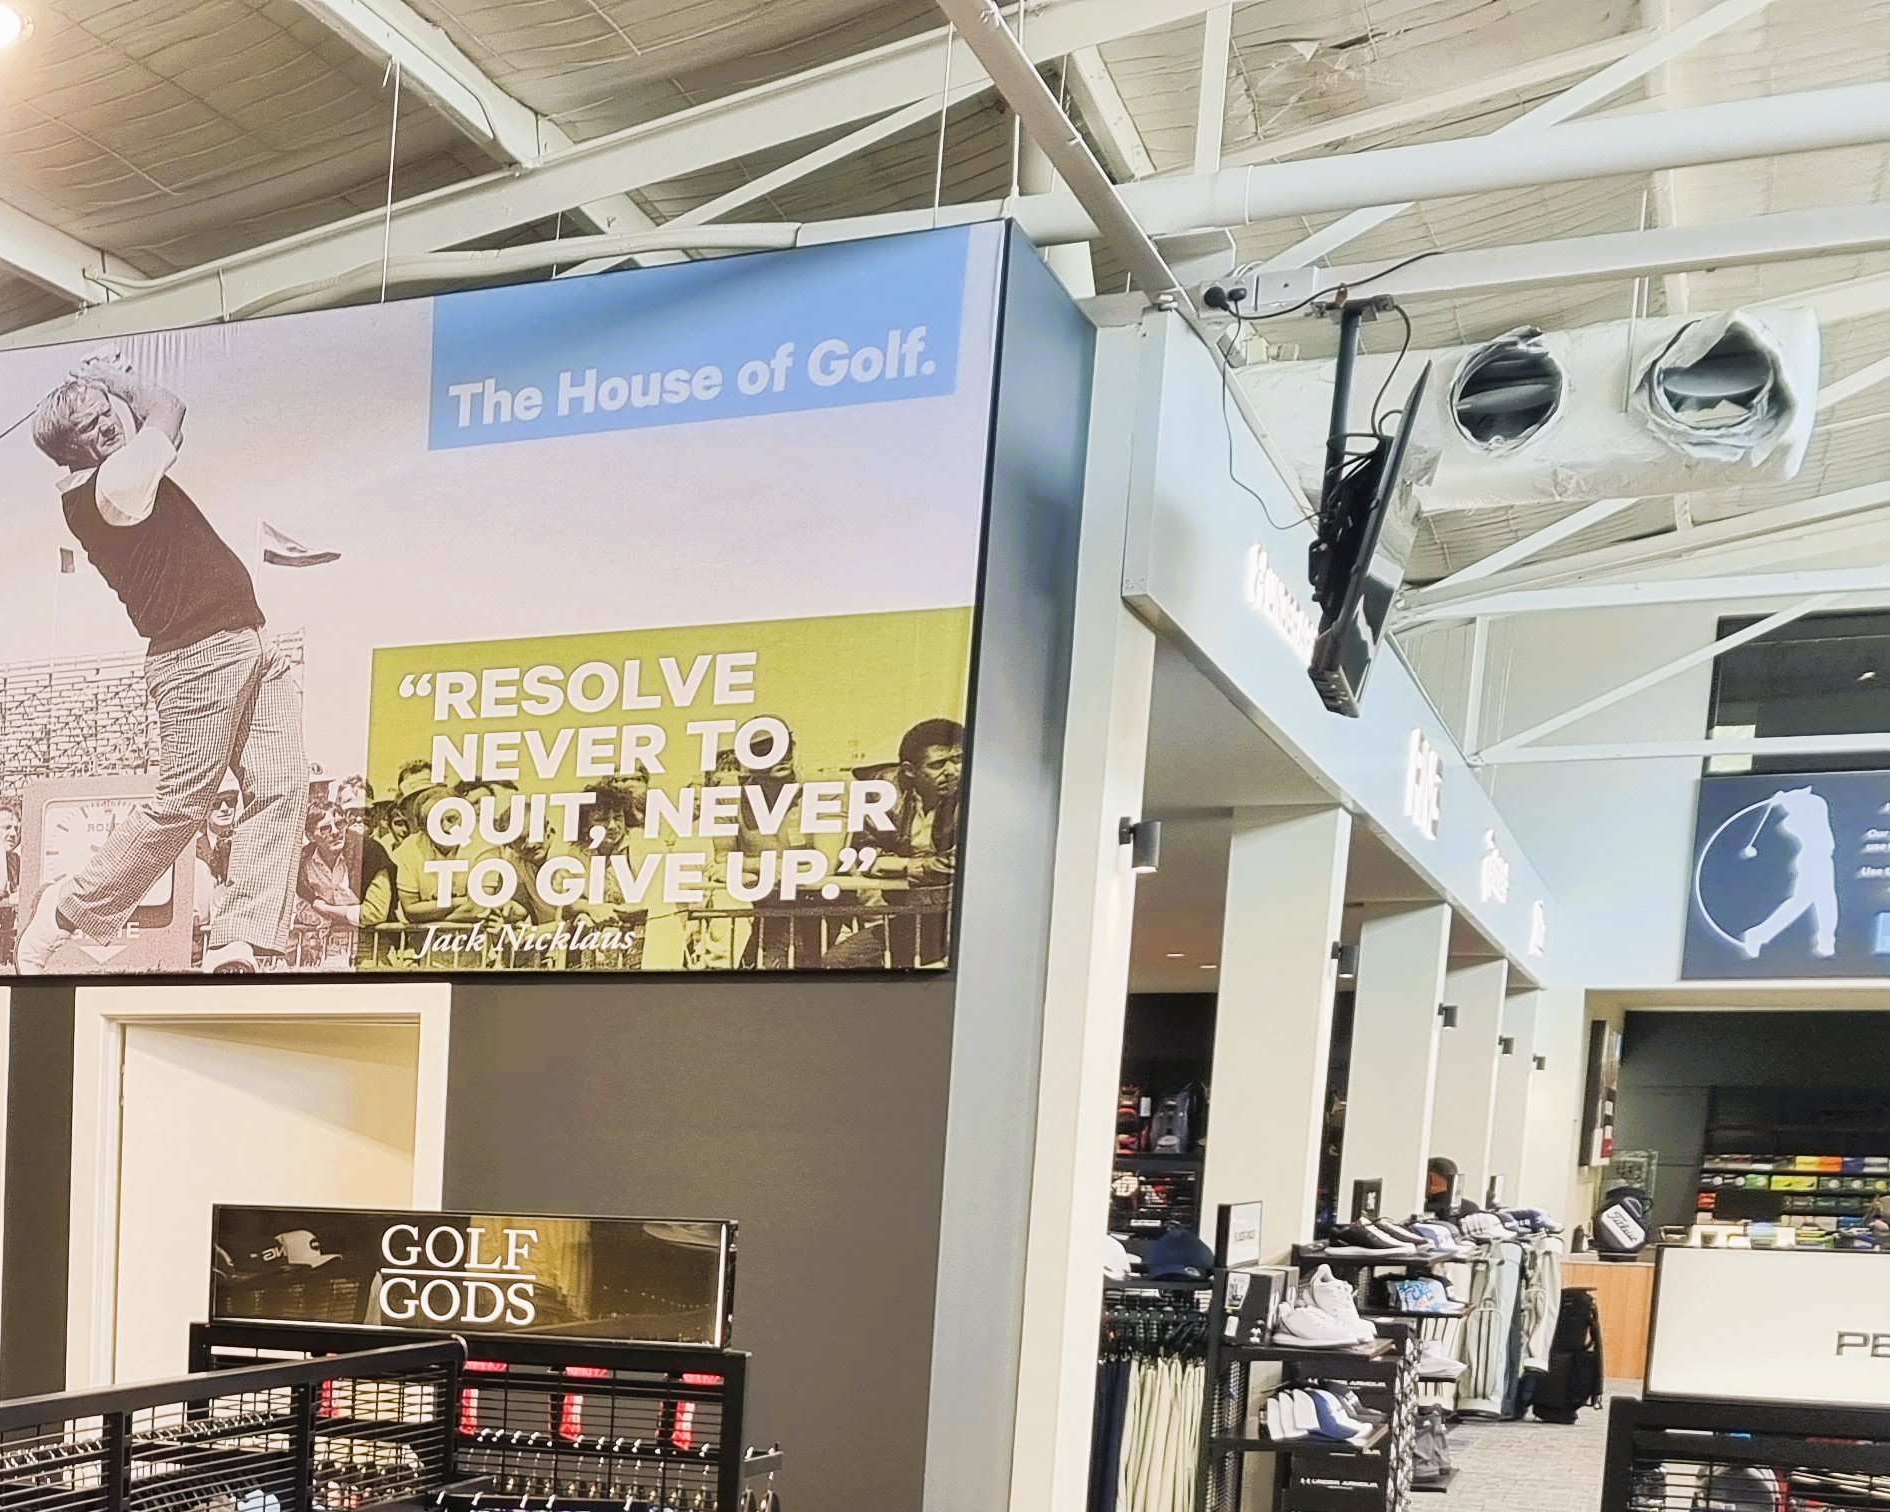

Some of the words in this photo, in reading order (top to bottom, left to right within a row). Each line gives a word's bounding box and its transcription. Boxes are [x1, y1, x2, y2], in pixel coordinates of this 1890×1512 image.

[448, 376, 542, 429] The
[556, 358, 722, 416] House
[737, 341, 796, 395] of
[807, 325, 937, 388] Golf.
[398, 650, 759, 721] “RESOLVE
[429, 723, 667, 784] NEVER
[685, 716, 793, 772] TO
[424, 790, 606, 850] QUIT,
[641, 779, 898, 840] NEVER
[423, 857, 517, 909] TO
[535, 851, 707, 907] GIVE
[725, 845, 879, 901] UP.”
[412, 920, 485, 960] Jack
[494, 920, 636, 952] Nicklaus
[380, 1223, 539, 1272] GOLF
[378, 1276, 538, 1326] GODS
